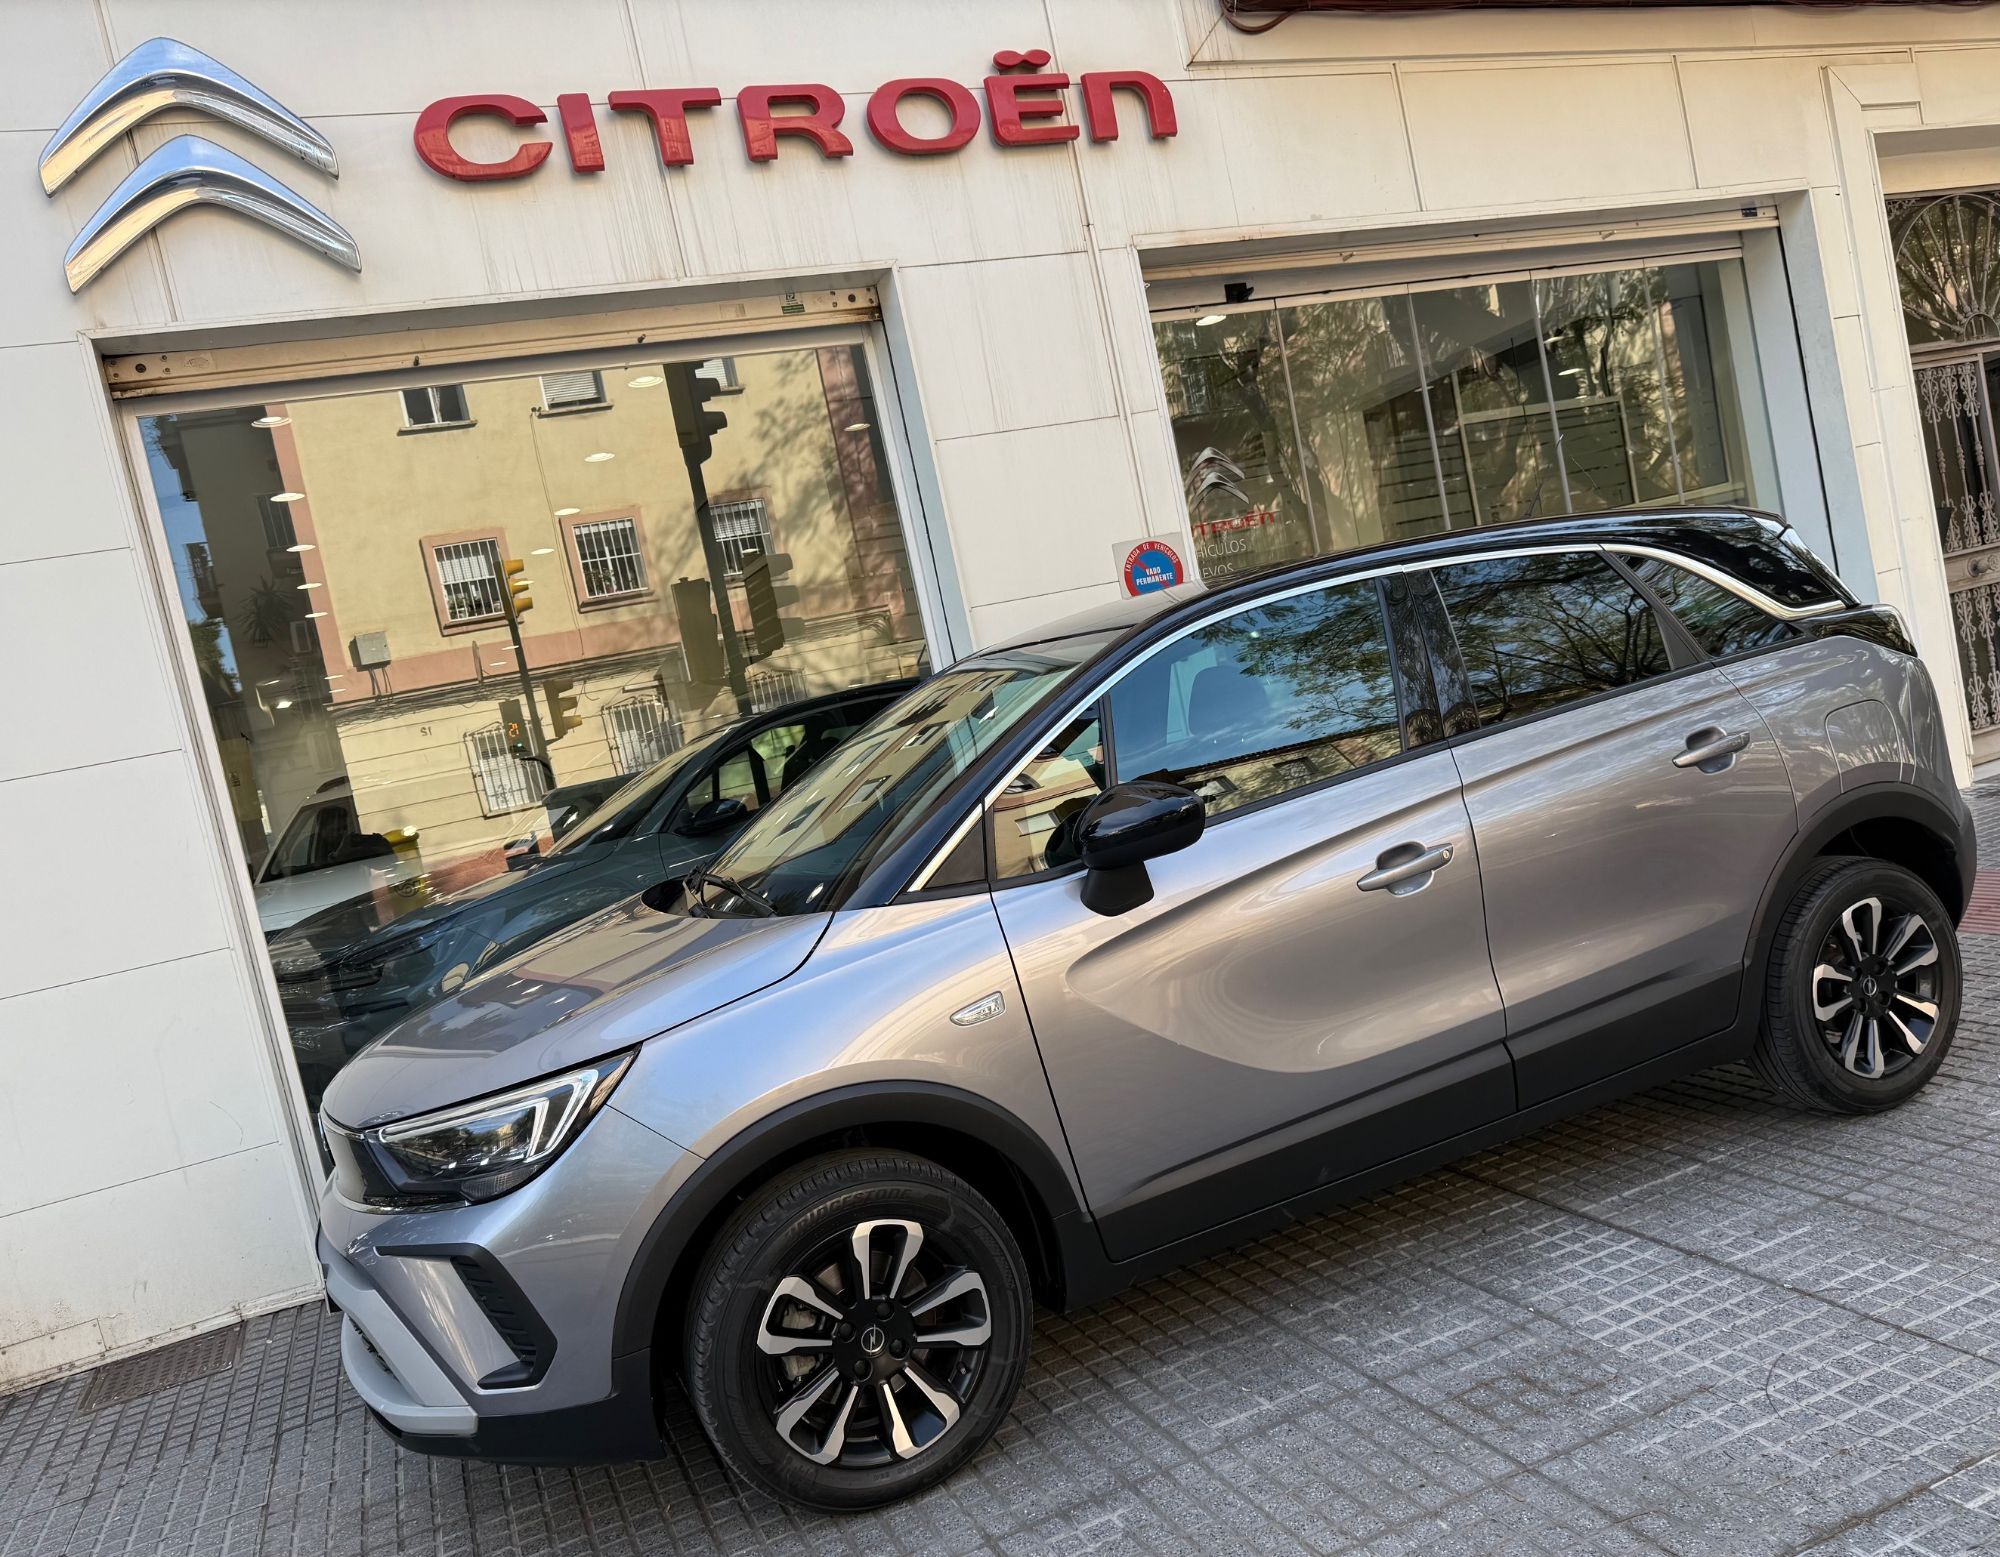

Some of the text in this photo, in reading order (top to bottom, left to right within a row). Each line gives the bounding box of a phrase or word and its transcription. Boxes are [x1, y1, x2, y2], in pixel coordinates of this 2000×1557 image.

[413, 49, 1178, 182] CITROËN
[1125, 543, 1179, 572] ENTRADA DE VEHICULOS
[1145, 566, 1161, 576] VADO
[1199, 563, 1234, 578] EVOS
[1136, 572, 1174, 586] PERMANENTE
